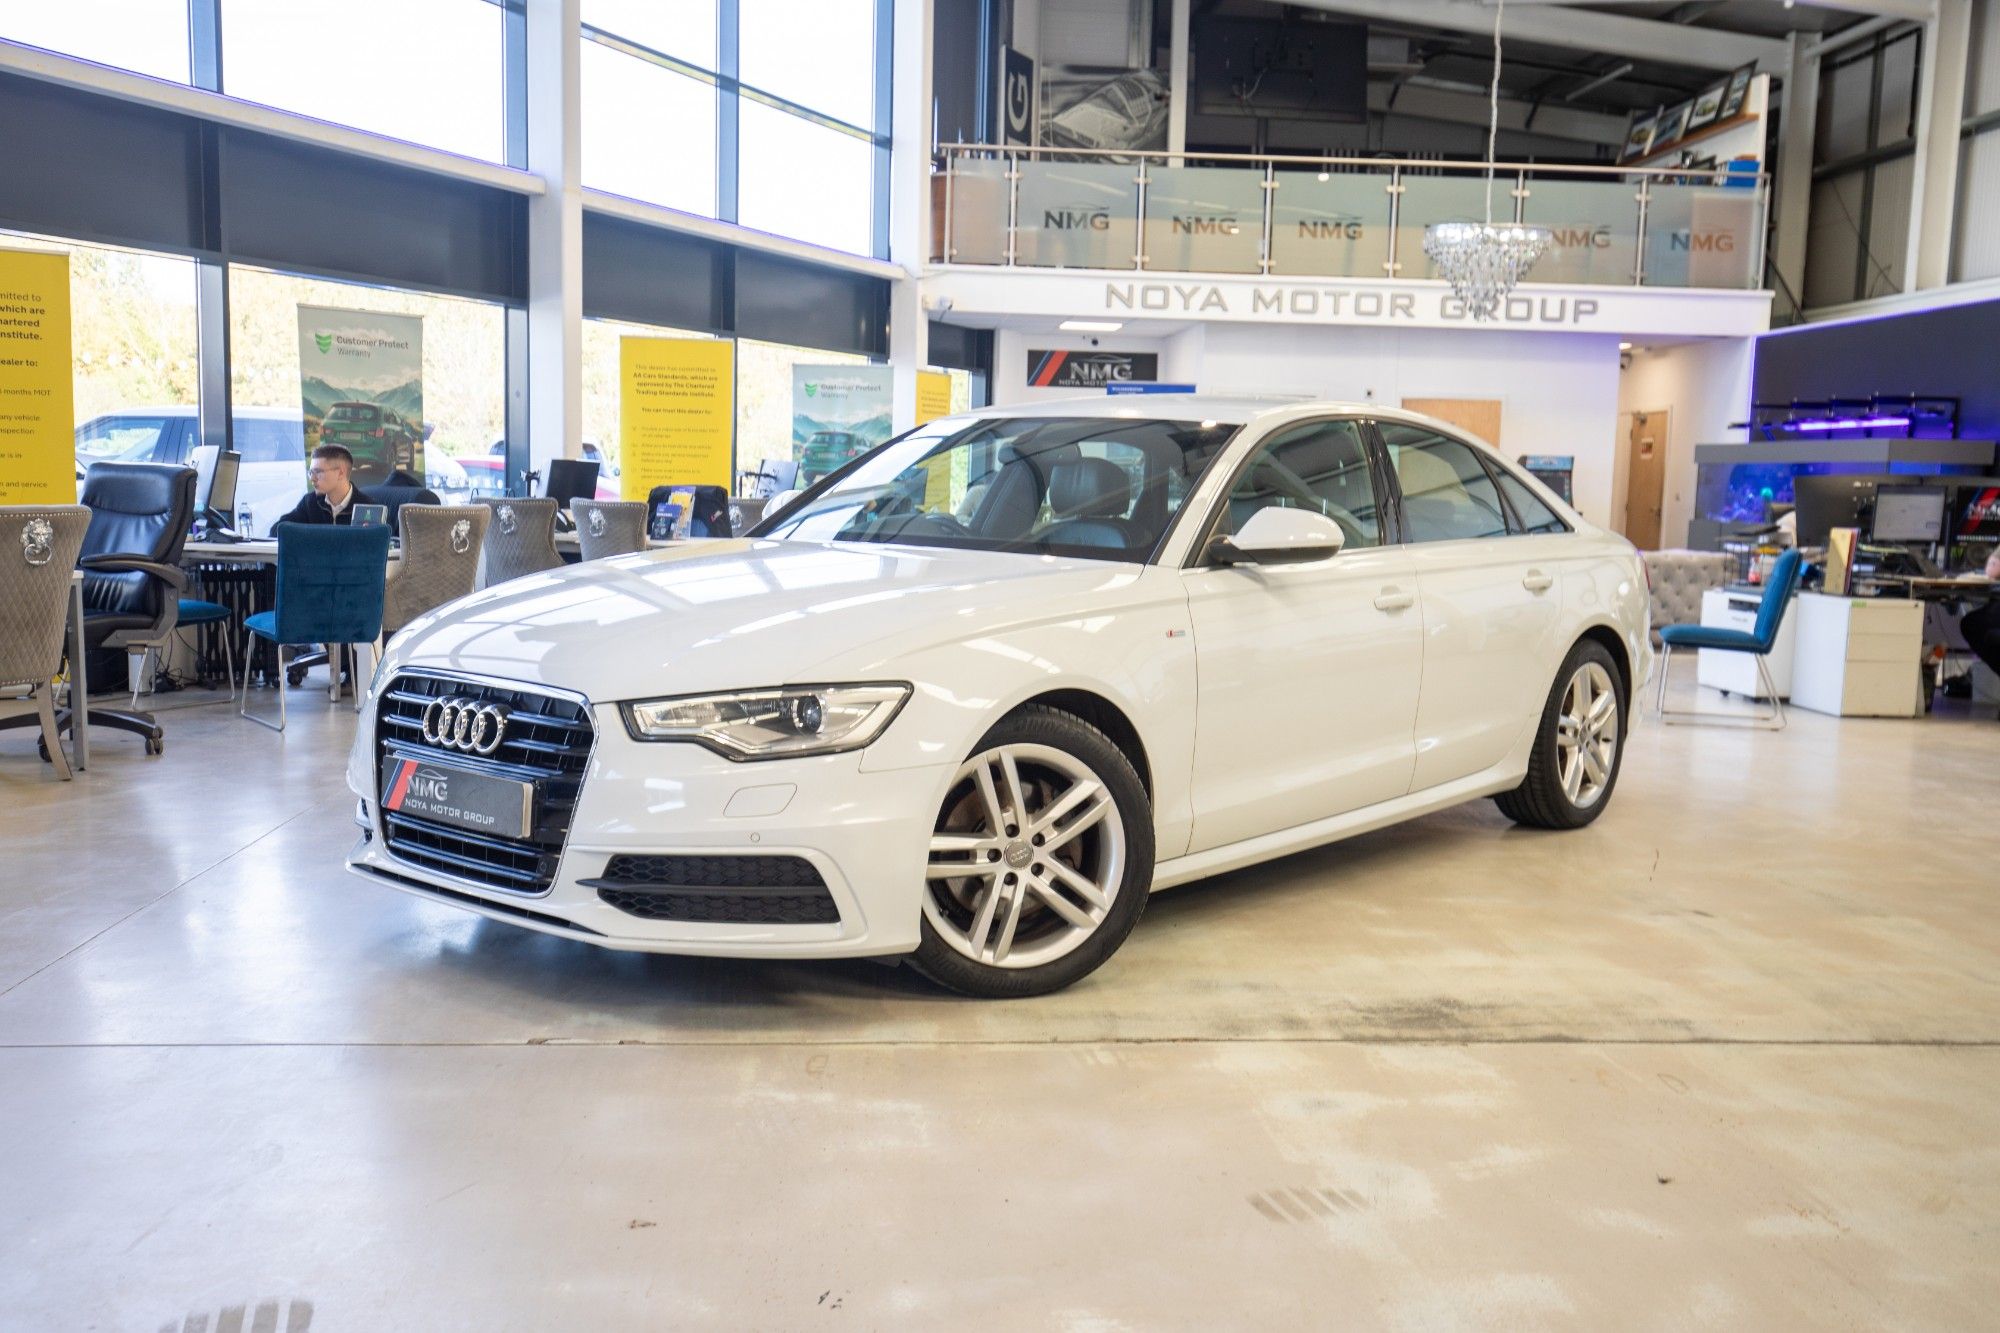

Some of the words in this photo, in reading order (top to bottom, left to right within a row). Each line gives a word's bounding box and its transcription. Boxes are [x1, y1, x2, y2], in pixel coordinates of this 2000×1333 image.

[1044, 210, 1109, 230] NMG
[1173, 215, 1237, 235] NMG
[1298, 220, 1363, 239] NMG
[1551, 229, 1611, 248] NMG
[1671, 231, 1734, 251] NMG
[32, 293, 41, 302] to
[1106, 282, 1229, 312] NOYA
[1253, 287, 1416, 318] MOTOR
[30, 307, 45, 315] are
[336, 335, 376, 347] Customer
[378, 338, 409, 350] Protect
[26, 359, 38, 367] to:
[1070, 361, 1132, 380] NMG
[406, 775, 448, 801] NMG
[405, 798, 427, 810] NOYA
[430, 803, 461, 818] MOTOR
[463, 810, 495, 825] GROUP
